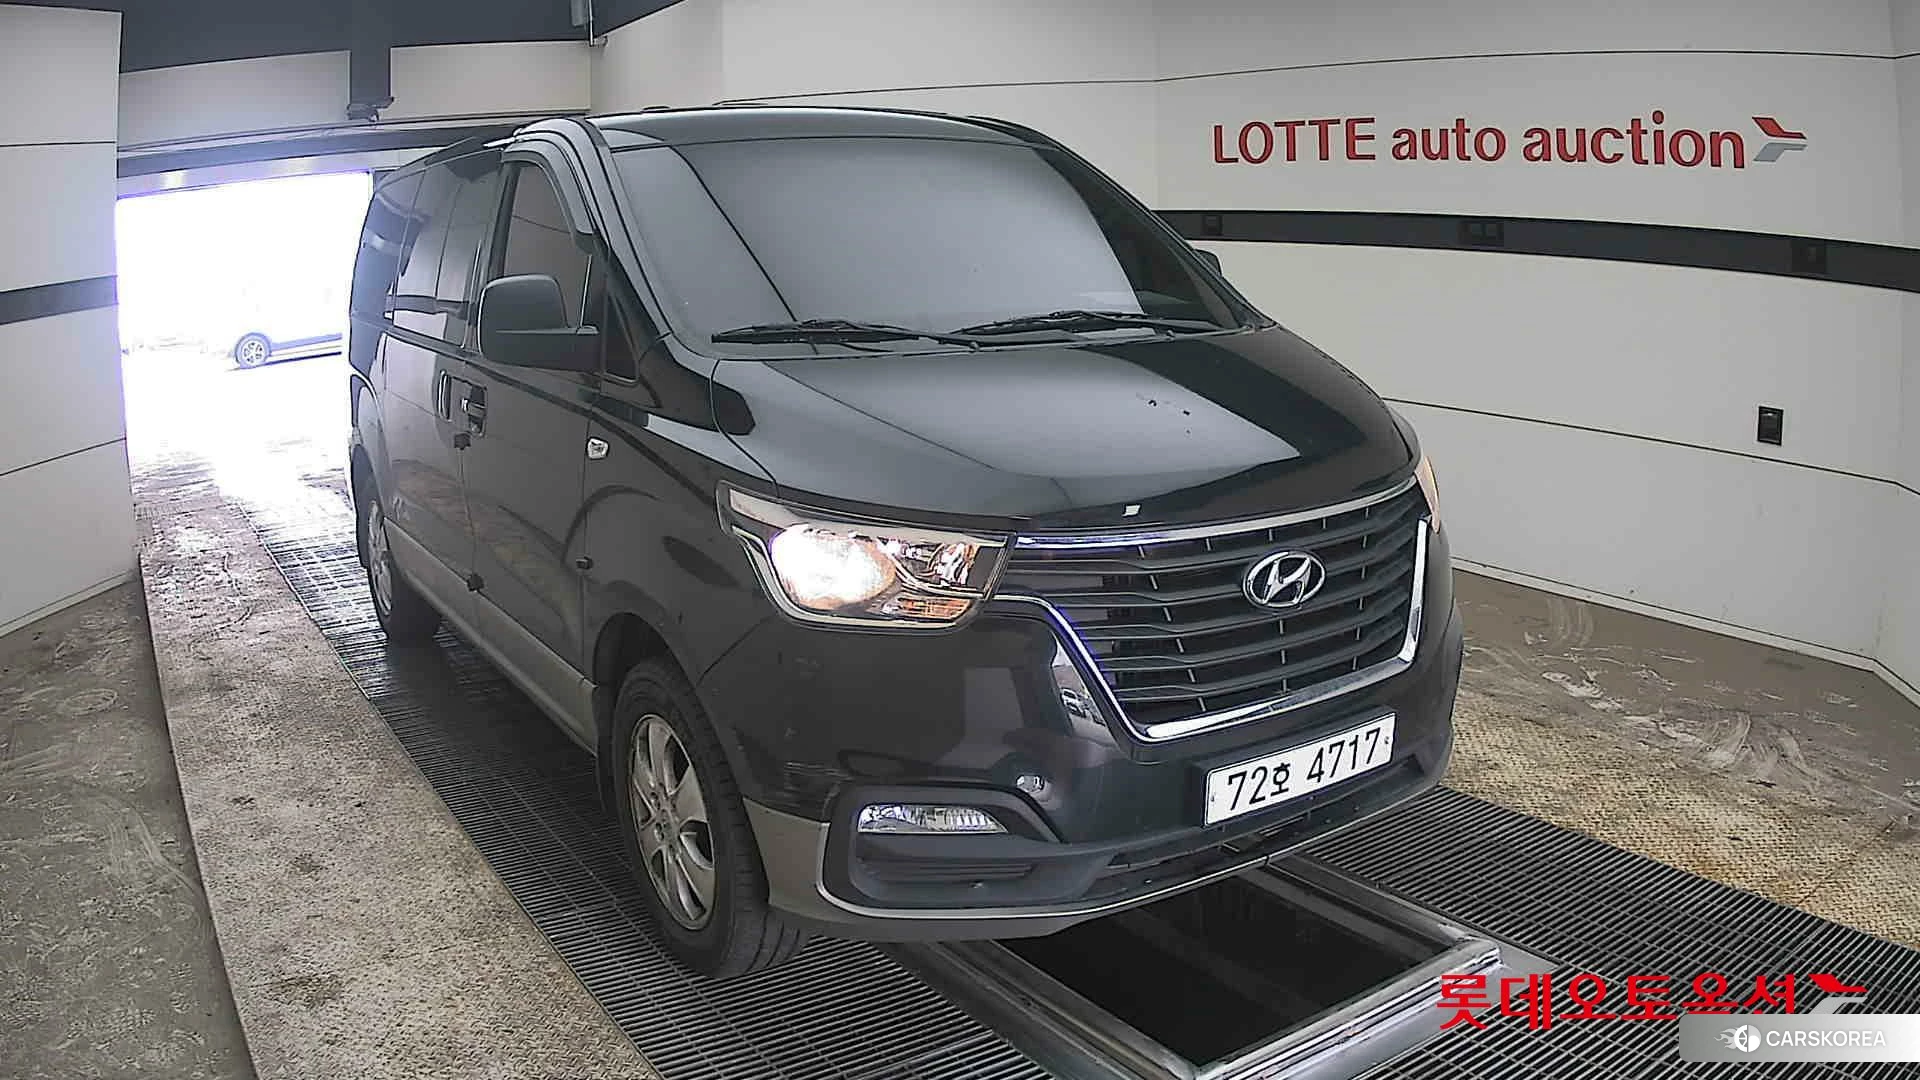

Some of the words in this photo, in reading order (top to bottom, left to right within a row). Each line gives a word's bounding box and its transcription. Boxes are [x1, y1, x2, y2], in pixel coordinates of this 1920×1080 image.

[1213, 117, 1376, 164] LOTTE
[1391, 117, 1506, 162] auto
[1522, 110, 1745, 169] auction
[1227, 762, 1292, 811] 72호
[1306, 727, 1381, 783] 4717
